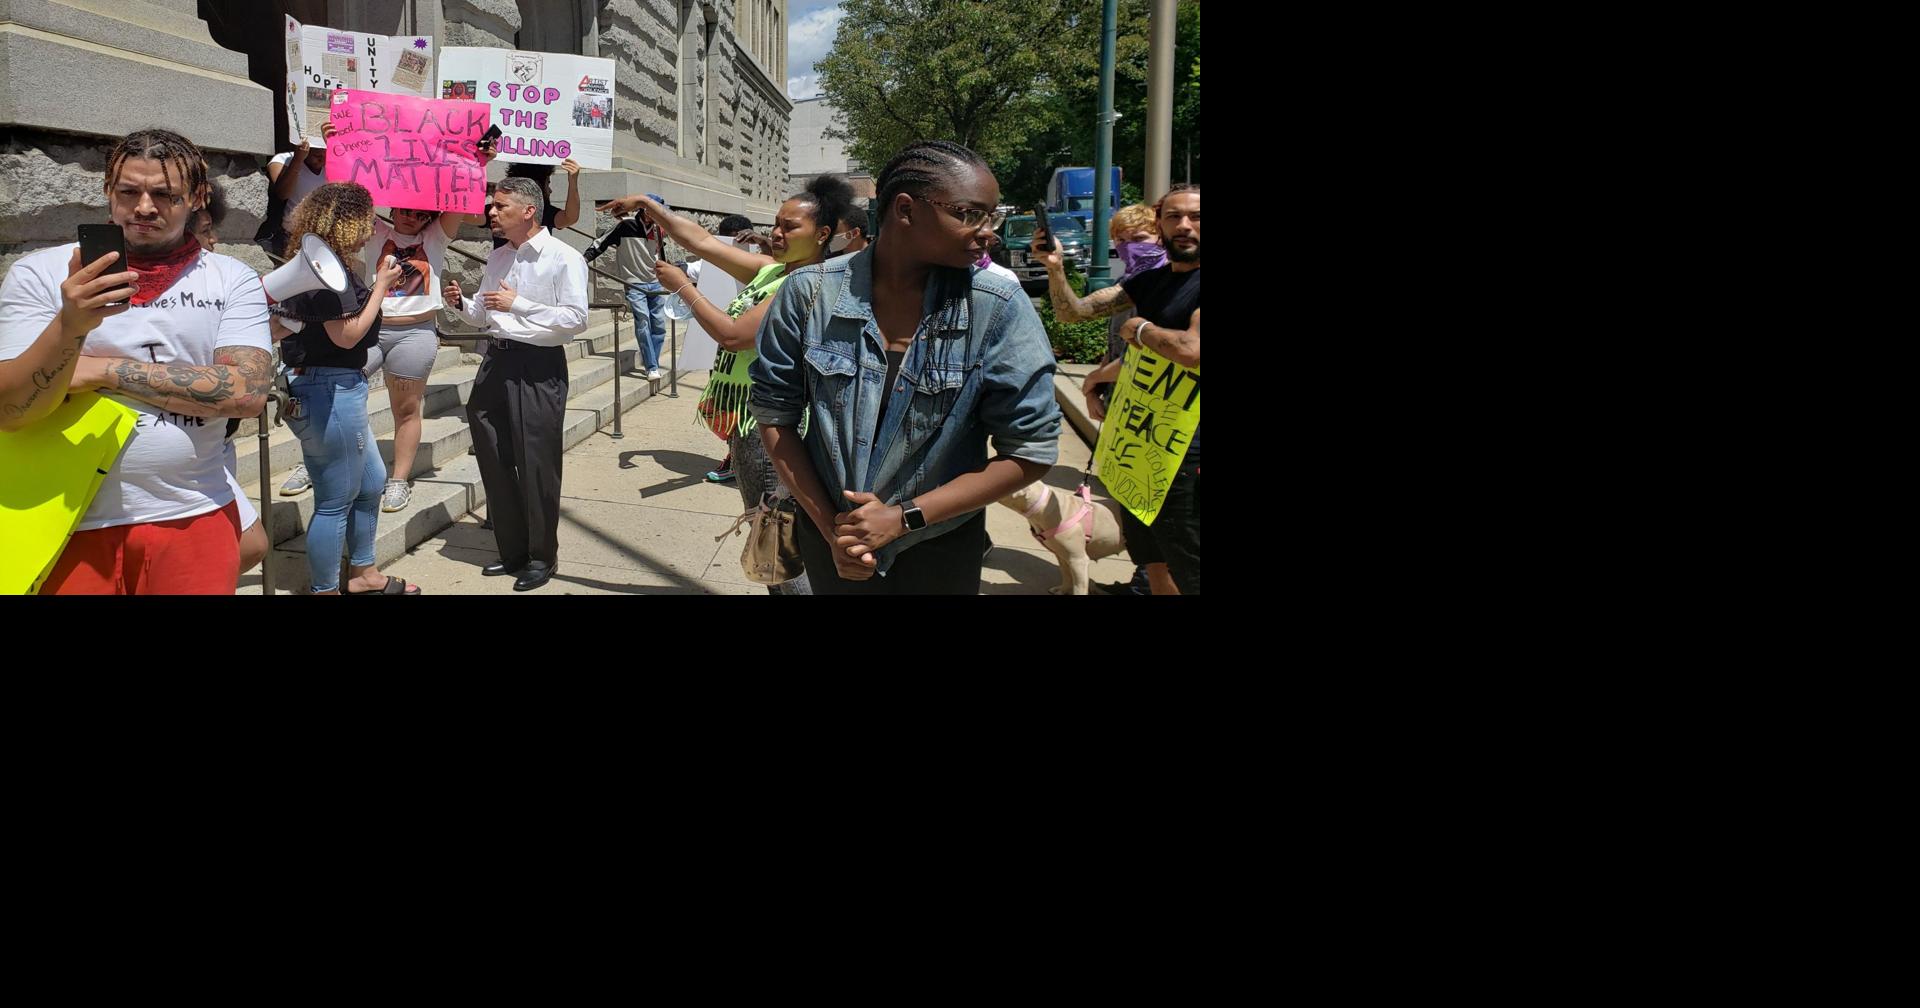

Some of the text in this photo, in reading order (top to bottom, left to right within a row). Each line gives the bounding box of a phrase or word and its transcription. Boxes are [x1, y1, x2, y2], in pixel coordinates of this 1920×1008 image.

[367, 37, 378, 88] UNITY
[488, 81, 561, 106] STOP
[354, 101, 486, 136] BLACK
[500, 108, 548, 131] THE
[374, 134, 481, 167] LIVES
[496, 135, 571, 159] ILLING
[1118, 397, 1187, 456] PEACE
